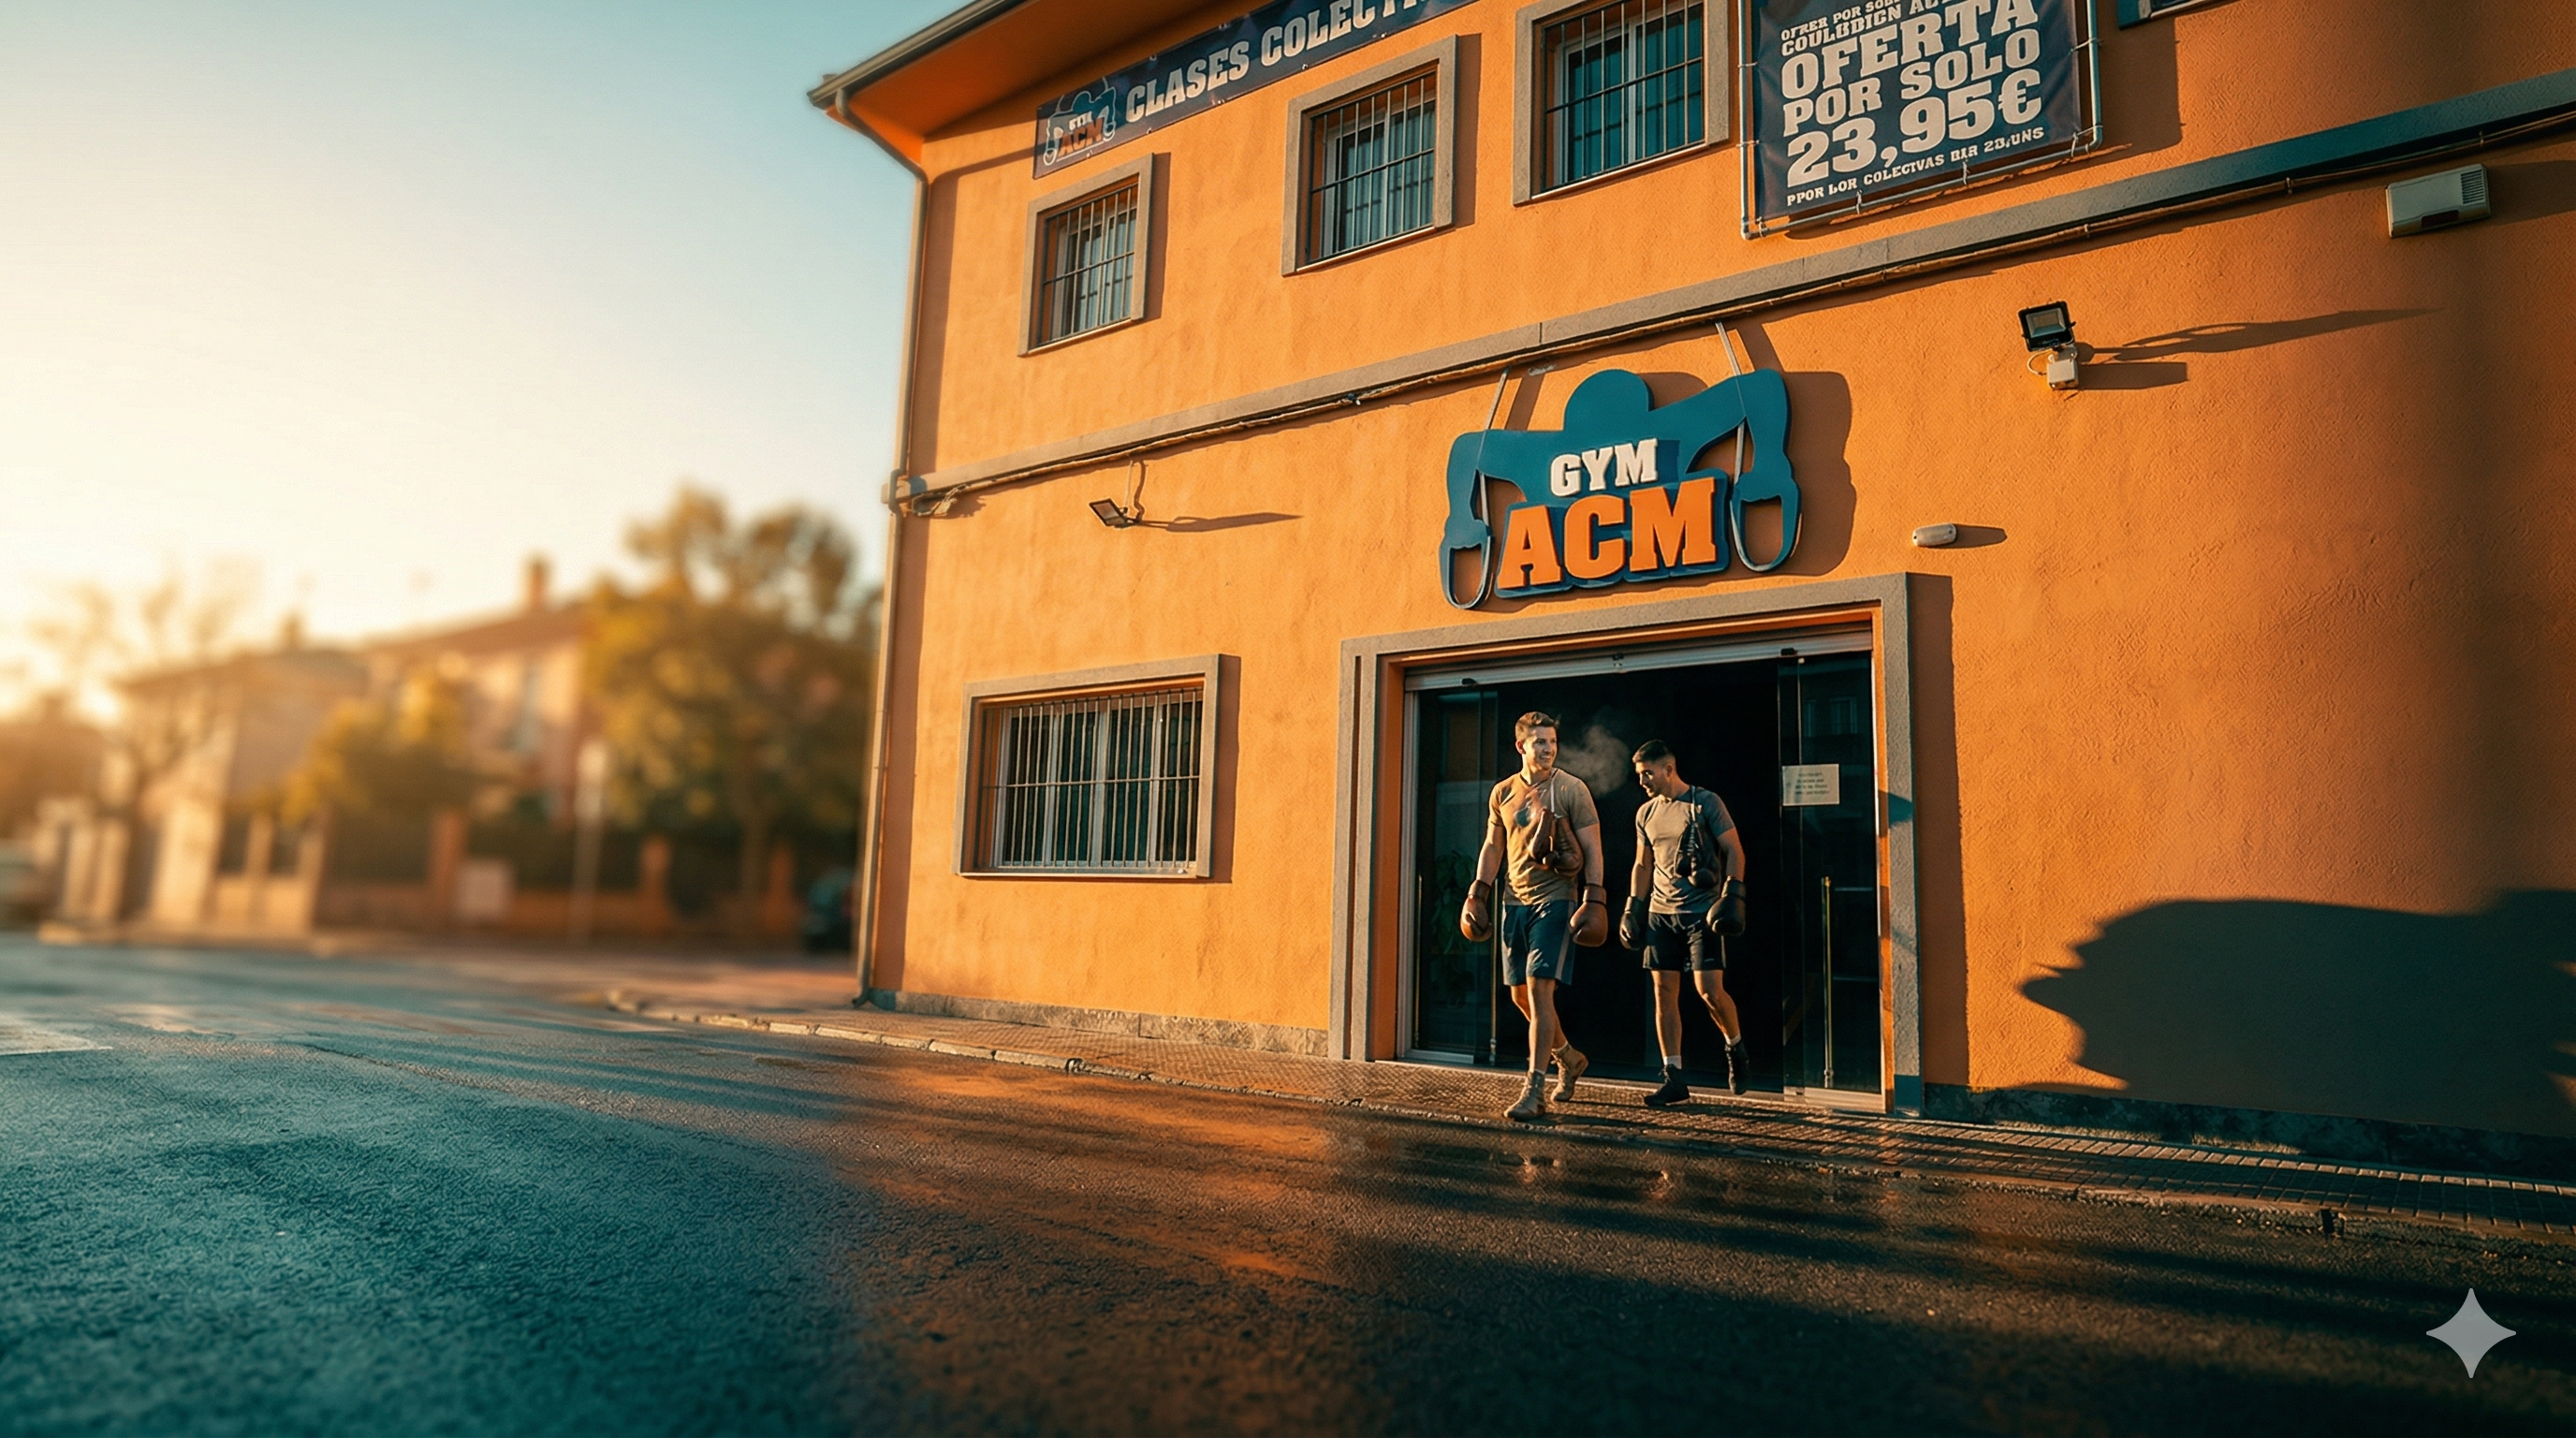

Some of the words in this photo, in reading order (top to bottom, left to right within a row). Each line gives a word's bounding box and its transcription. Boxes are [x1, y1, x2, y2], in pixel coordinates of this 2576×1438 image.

[1781, 0, 2038, 98] OFERTA
[1833, 6, 1862, 24] POR
[1126, 40, 1250, 123] CLASES
[1783, 77, 1881, 137] POR
[1900, 28, 2040, 100] SOLO
[1787, 68, 2042, 187] 23,95€
[1786, 186, 1825, 207] PPOR
[1550, 437, 1658, 497] GYM
[1498, 477, 1716, 589] ACM
